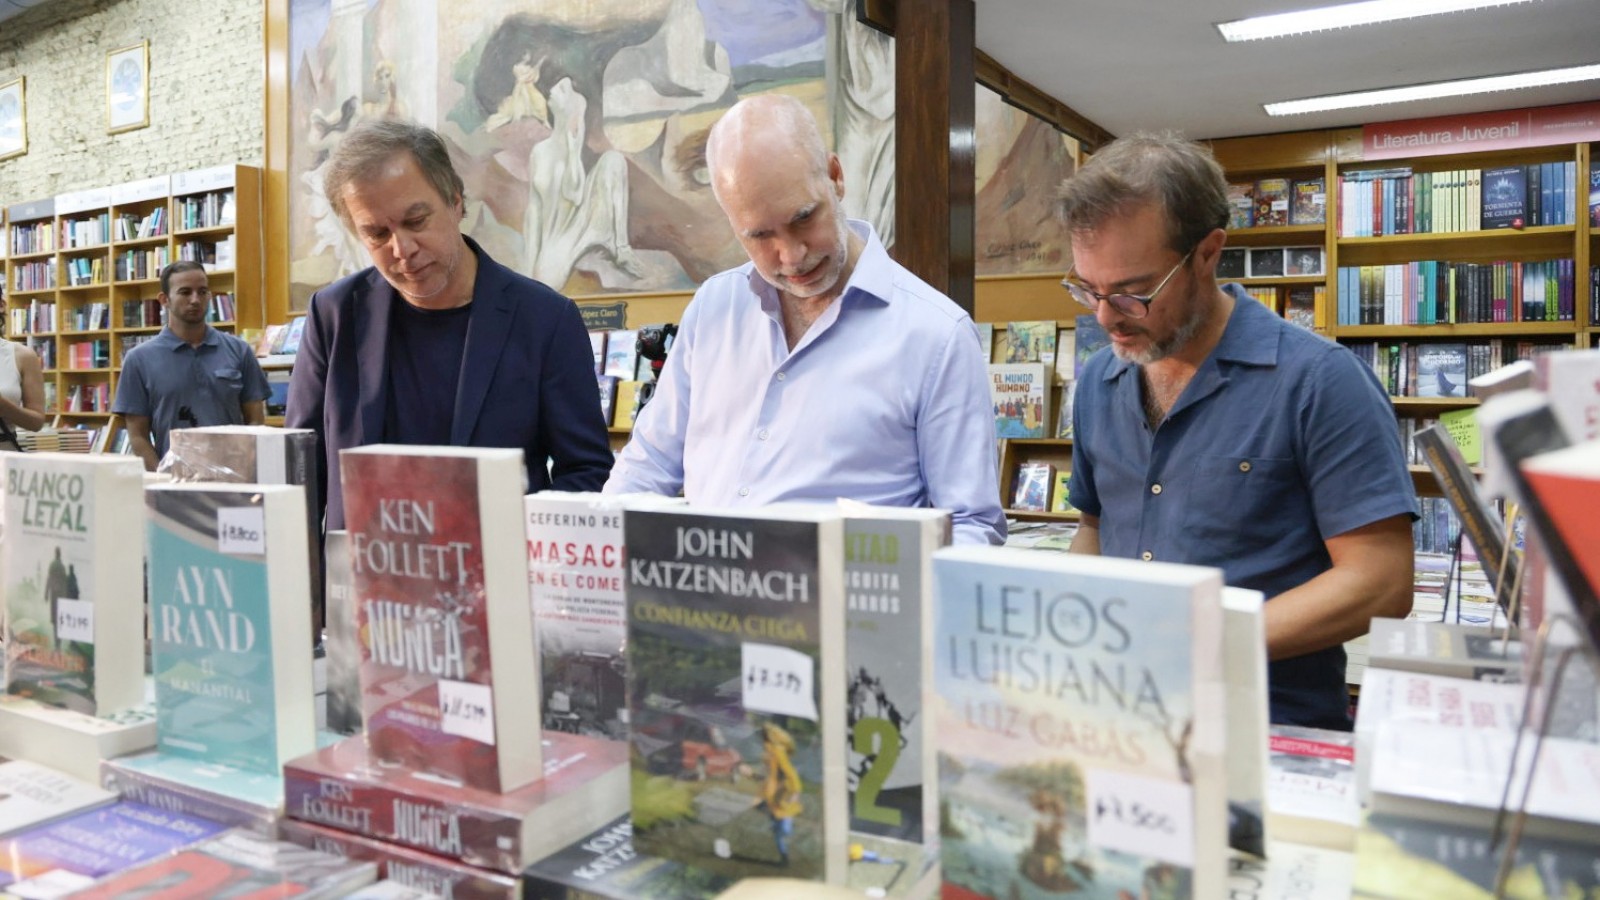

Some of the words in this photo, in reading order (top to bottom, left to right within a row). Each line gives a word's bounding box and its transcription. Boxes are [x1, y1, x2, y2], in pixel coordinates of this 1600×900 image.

[1373, 125, 1452, 150] Literatura
[1456, 121, 1520, 143] Juvenil
[994, 374, 1003, 383] EL
[1005, 373, 1033, 383] MUNDO
[996, 383, 1030, 392] HUMANO
[8, 468, 84, 503] BLANCO
[22, 498, 87, 533] LETAL
[380, 498, 435, 535] KEN
[530, 512, 596, 528] CEFERINO
[352, 533, 472, 586] FOLLETT
[675, 526, 753, 560] JOHN
[174, 565, 234, 609] AYN
[528, 570, 545, 585] EN
[551, 572, 570, 588] EL
[630, 558, 809, 603] KATZENBACH
[161, 603, 255, 654] RAND
[633, 601, 741, 632] CONFIANZA
[744, 614, 808, 640] CIEGA
[975, 581, 1131, 654] LEJOS
[366, 598, 465, 680] NUNCA
[949, 635, 1168, 723] LUISIANA
[964, 699, 1020, 739] LUZ
[320, 778, 352, 802] KEN
[853, 715, 904, 826] 2
[303, 792, 372, 834] FOLLETT
[393, 798, 462, 856] NUNCA
